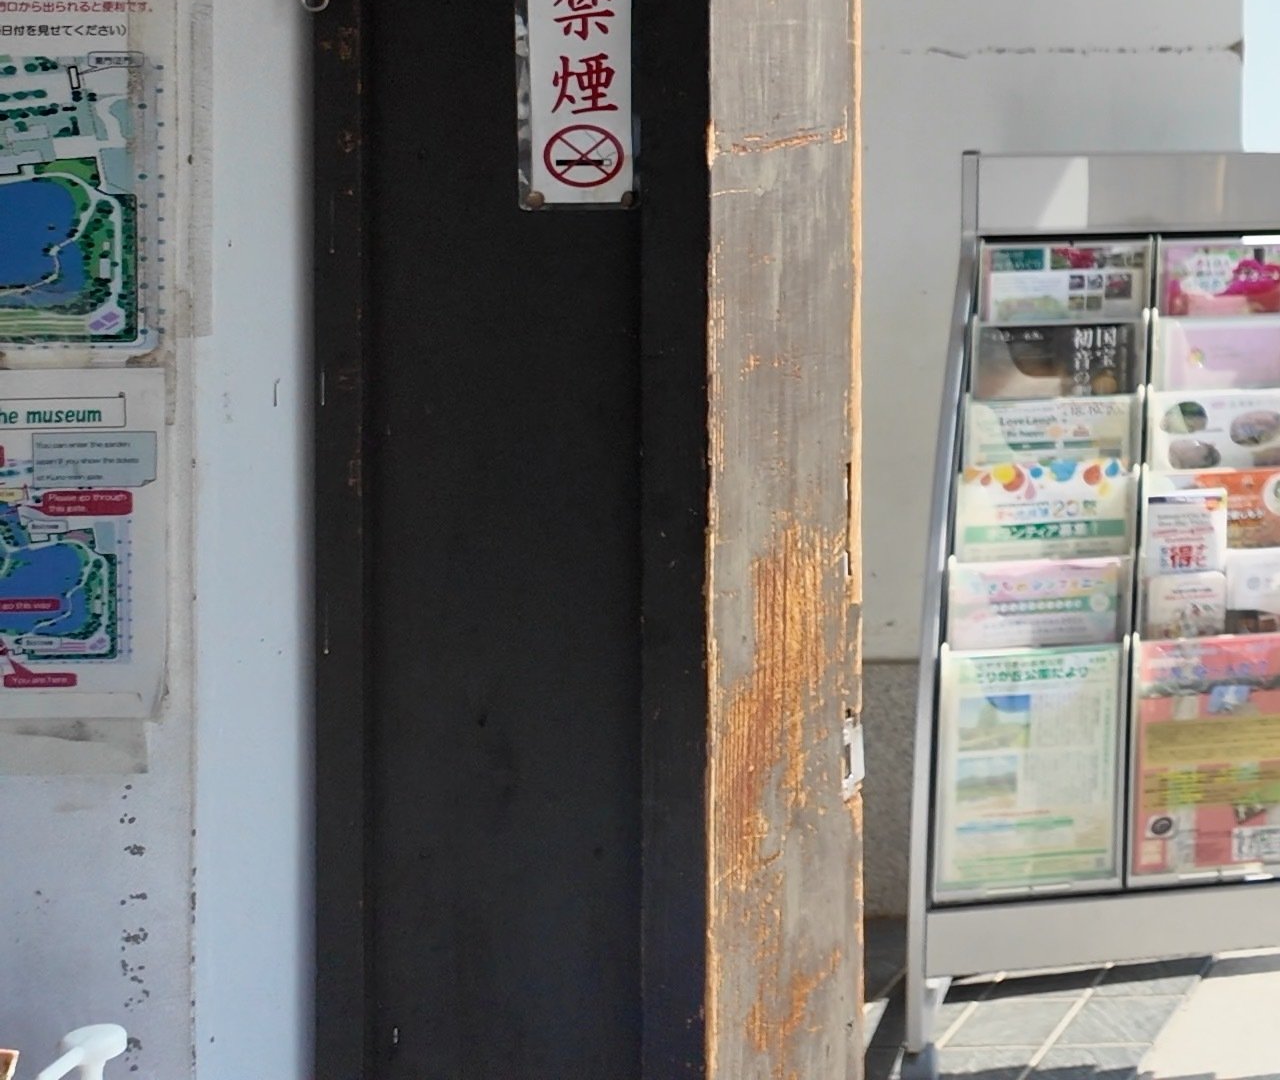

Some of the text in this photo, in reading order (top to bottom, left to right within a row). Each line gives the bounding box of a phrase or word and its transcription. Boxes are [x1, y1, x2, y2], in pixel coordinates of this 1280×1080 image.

[0, 25, 127, 37] 日付を見せてください)
[26, 408, 103, 424] museum
